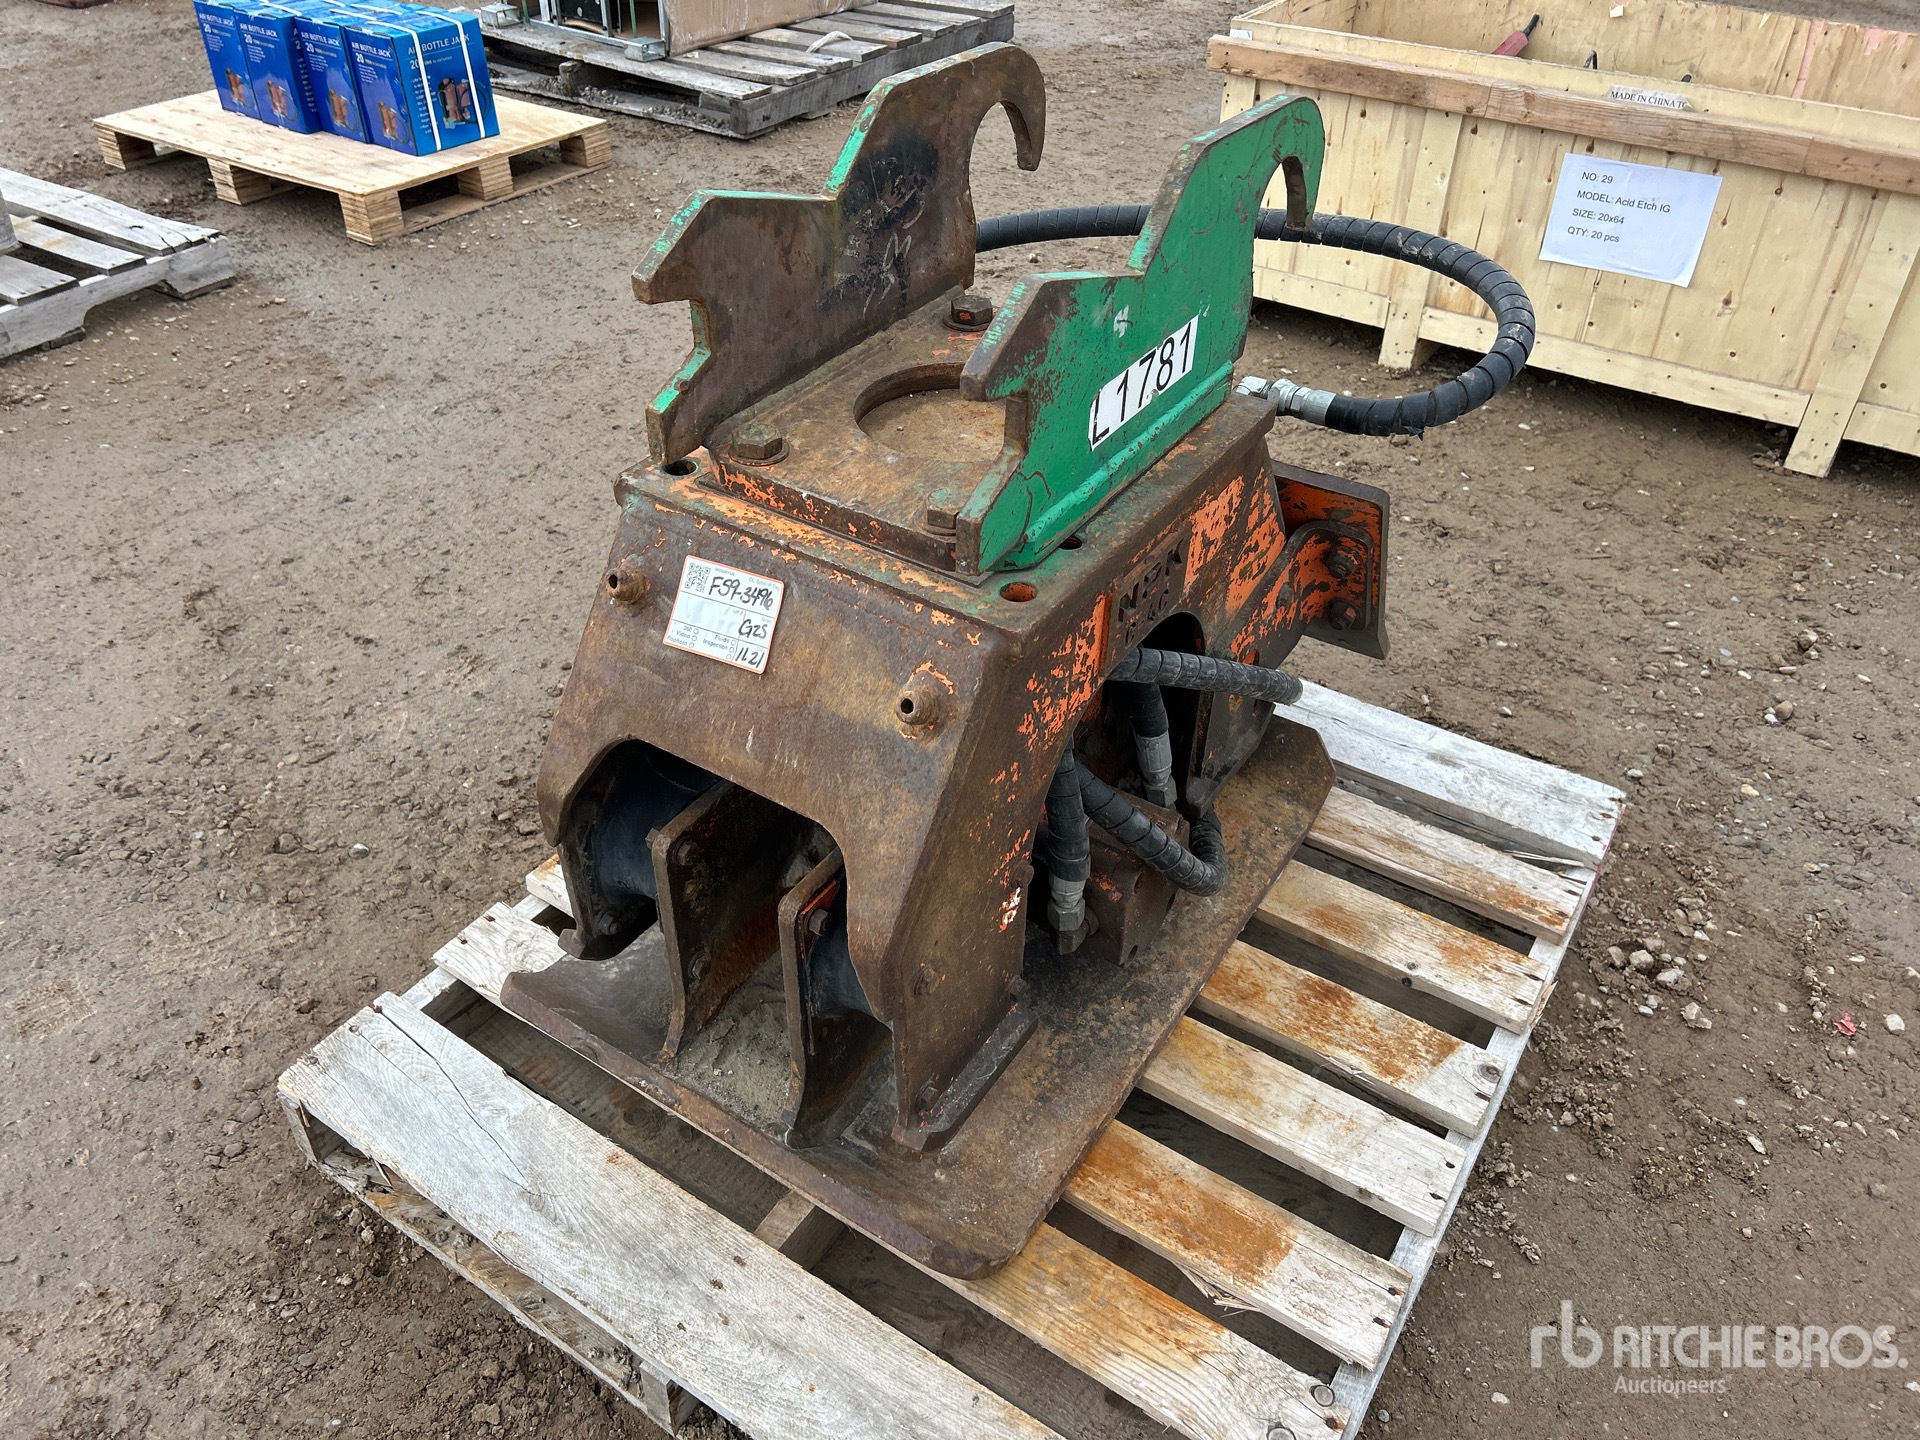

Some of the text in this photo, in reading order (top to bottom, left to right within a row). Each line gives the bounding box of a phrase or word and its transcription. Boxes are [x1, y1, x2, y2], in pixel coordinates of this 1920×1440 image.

[422, 38, 450, 52] BOTTLE
[451, 33, 470, 45] JAK
[1610, 90, 1636, 101] MADE
[1637, 94, 1648, 102] IN
[1648, 96, 1675, 108] CHINA
[1582, 171, 1614, 184] NO: 29
[1576, 190, 1671, 214] MODEL: Acid Etch IG
[1572, 208, 1625, 224] SIZE: 20x64
[1567, 226, 1620, 242] QTY: 20 pcs
[676, 630, 691, 639] Video
[714, 634, 730, 643] Fluids
[702, 638, 729, 650] Inspection
